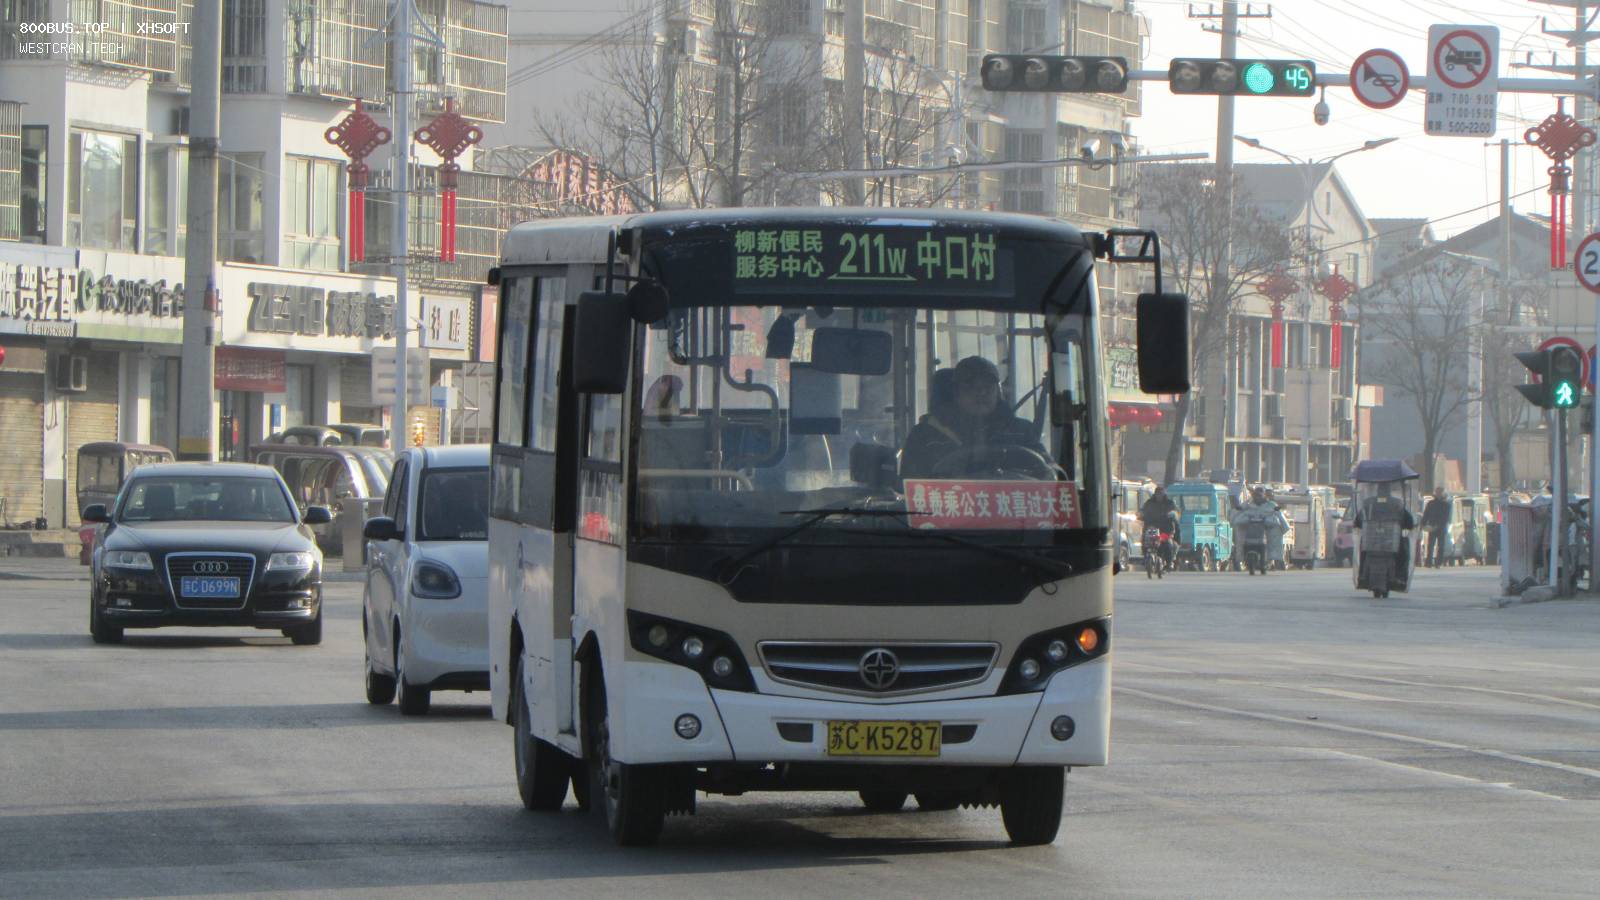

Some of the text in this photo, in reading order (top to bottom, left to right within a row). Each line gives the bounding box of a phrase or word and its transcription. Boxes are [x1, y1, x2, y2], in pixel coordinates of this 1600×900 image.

[1285, 68, 1309, 90] 45
[734, 230, 823, 253] 柳新便民
[735, 255, 825, 279] 服务中心
[917, 231, 997, 281] 中口村
[911, 485, 1075, 518] 免费乘公交 欢喜过大年
